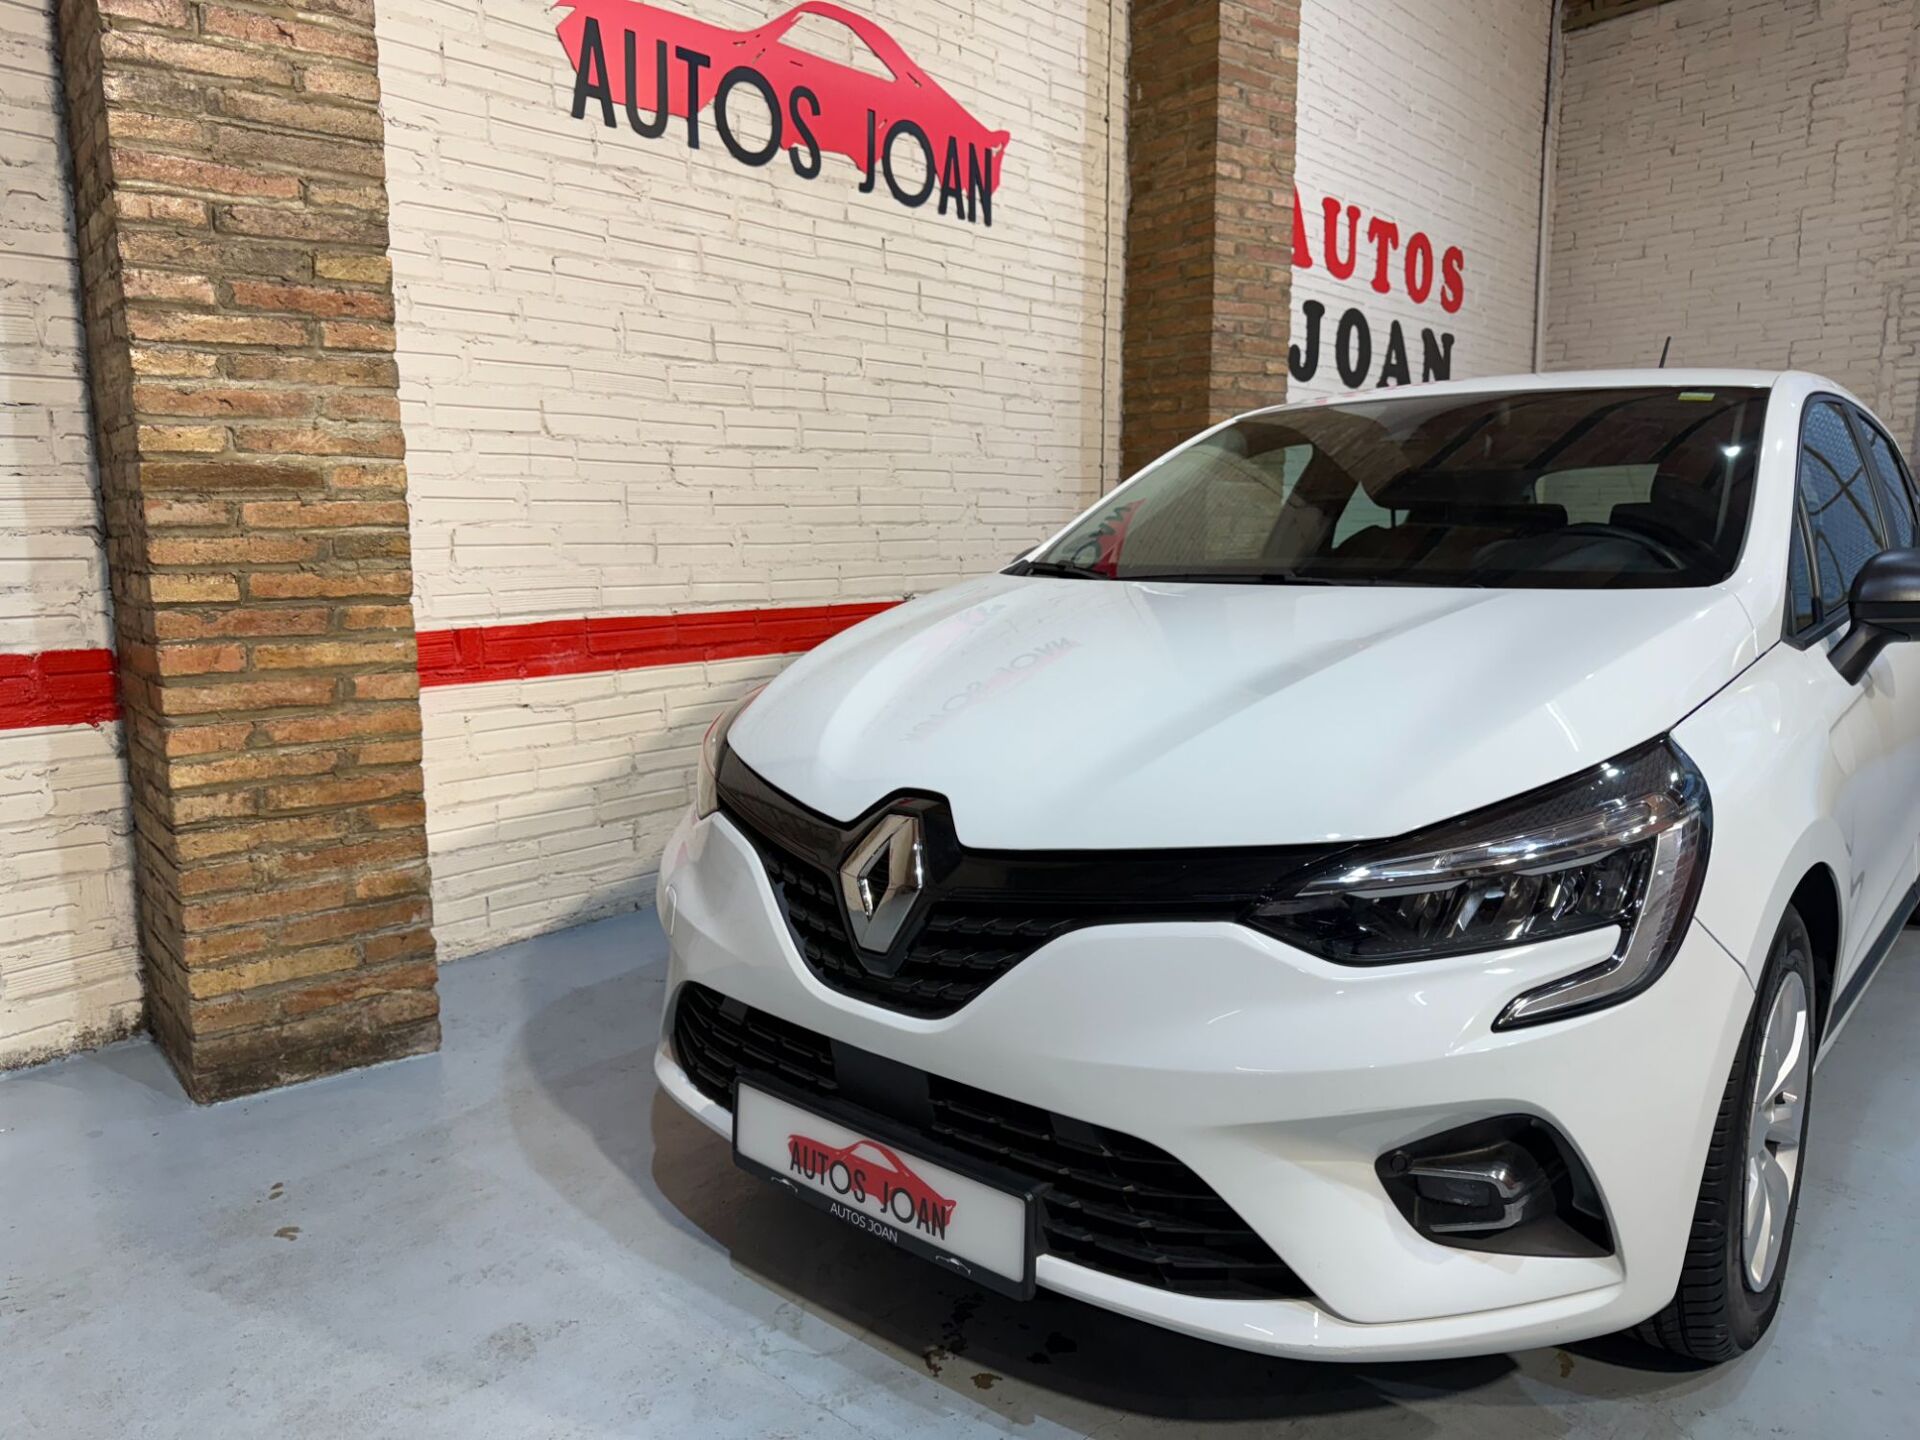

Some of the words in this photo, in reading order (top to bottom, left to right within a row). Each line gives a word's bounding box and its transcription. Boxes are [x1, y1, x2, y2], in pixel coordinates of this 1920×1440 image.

[571, 16, 822, 179] AUTOS
[858, 108, 992, 226] JOAN
[1288, 300, 1455, 389] JOAN
[789, 1141, 867, 1204] AUTOS
[880, 1181, 946, 1240] JOAN
[830, 1202, 866, 1229] AUTOS
[868, 1219, 898, 1243] JOAN
